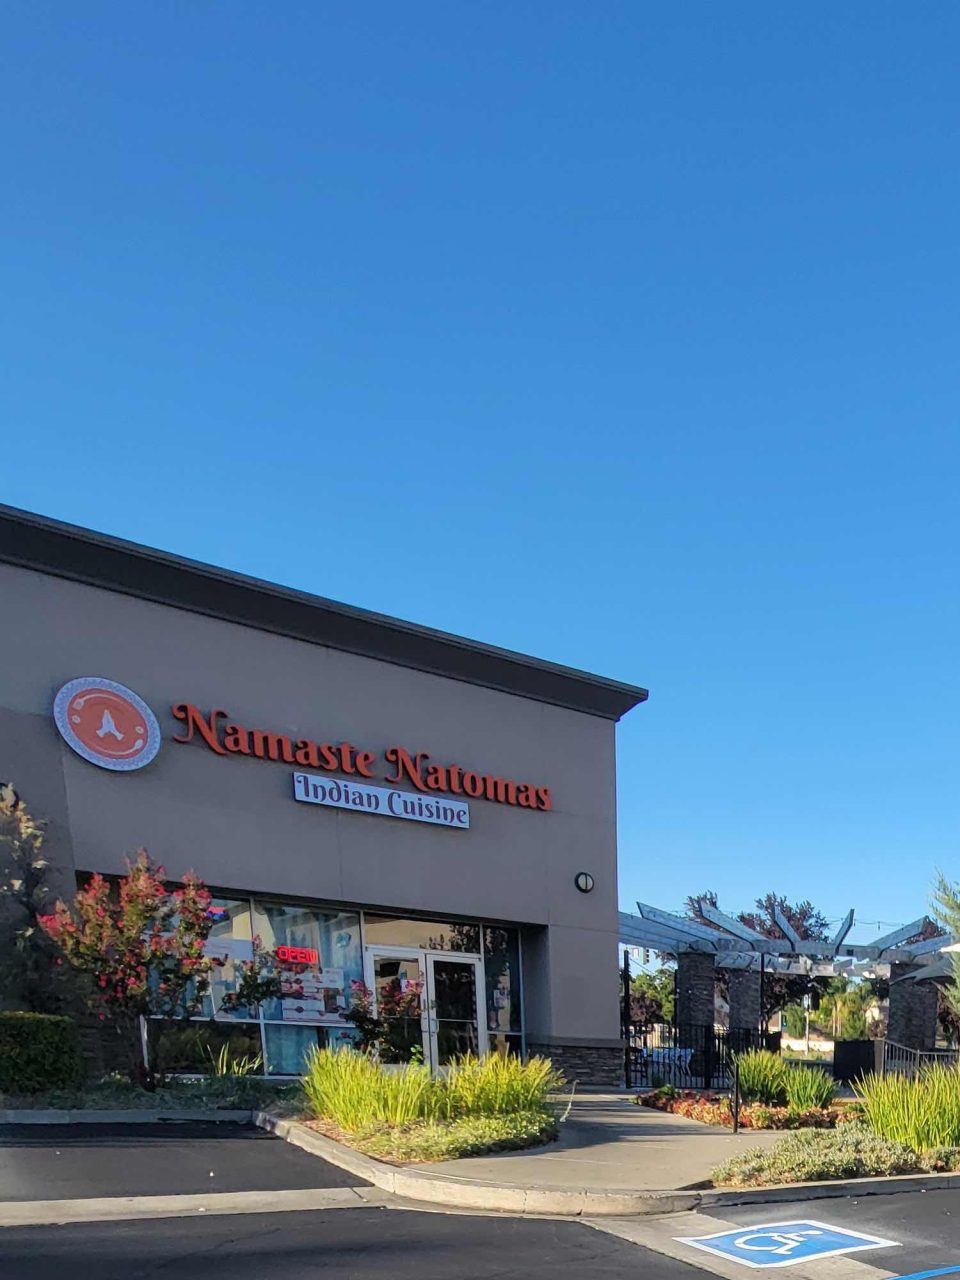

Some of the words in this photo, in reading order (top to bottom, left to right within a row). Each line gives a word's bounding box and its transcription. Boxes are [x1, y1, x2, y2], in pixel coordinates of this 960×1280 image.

[171, 702, 376, 778] Namaste
[385, 746, 552, 811] Natomas
[296, 774, 379, 812] Indian
[387, 791, 468, 825] Cuisine
[278, 945, 318, 964] OPEN
